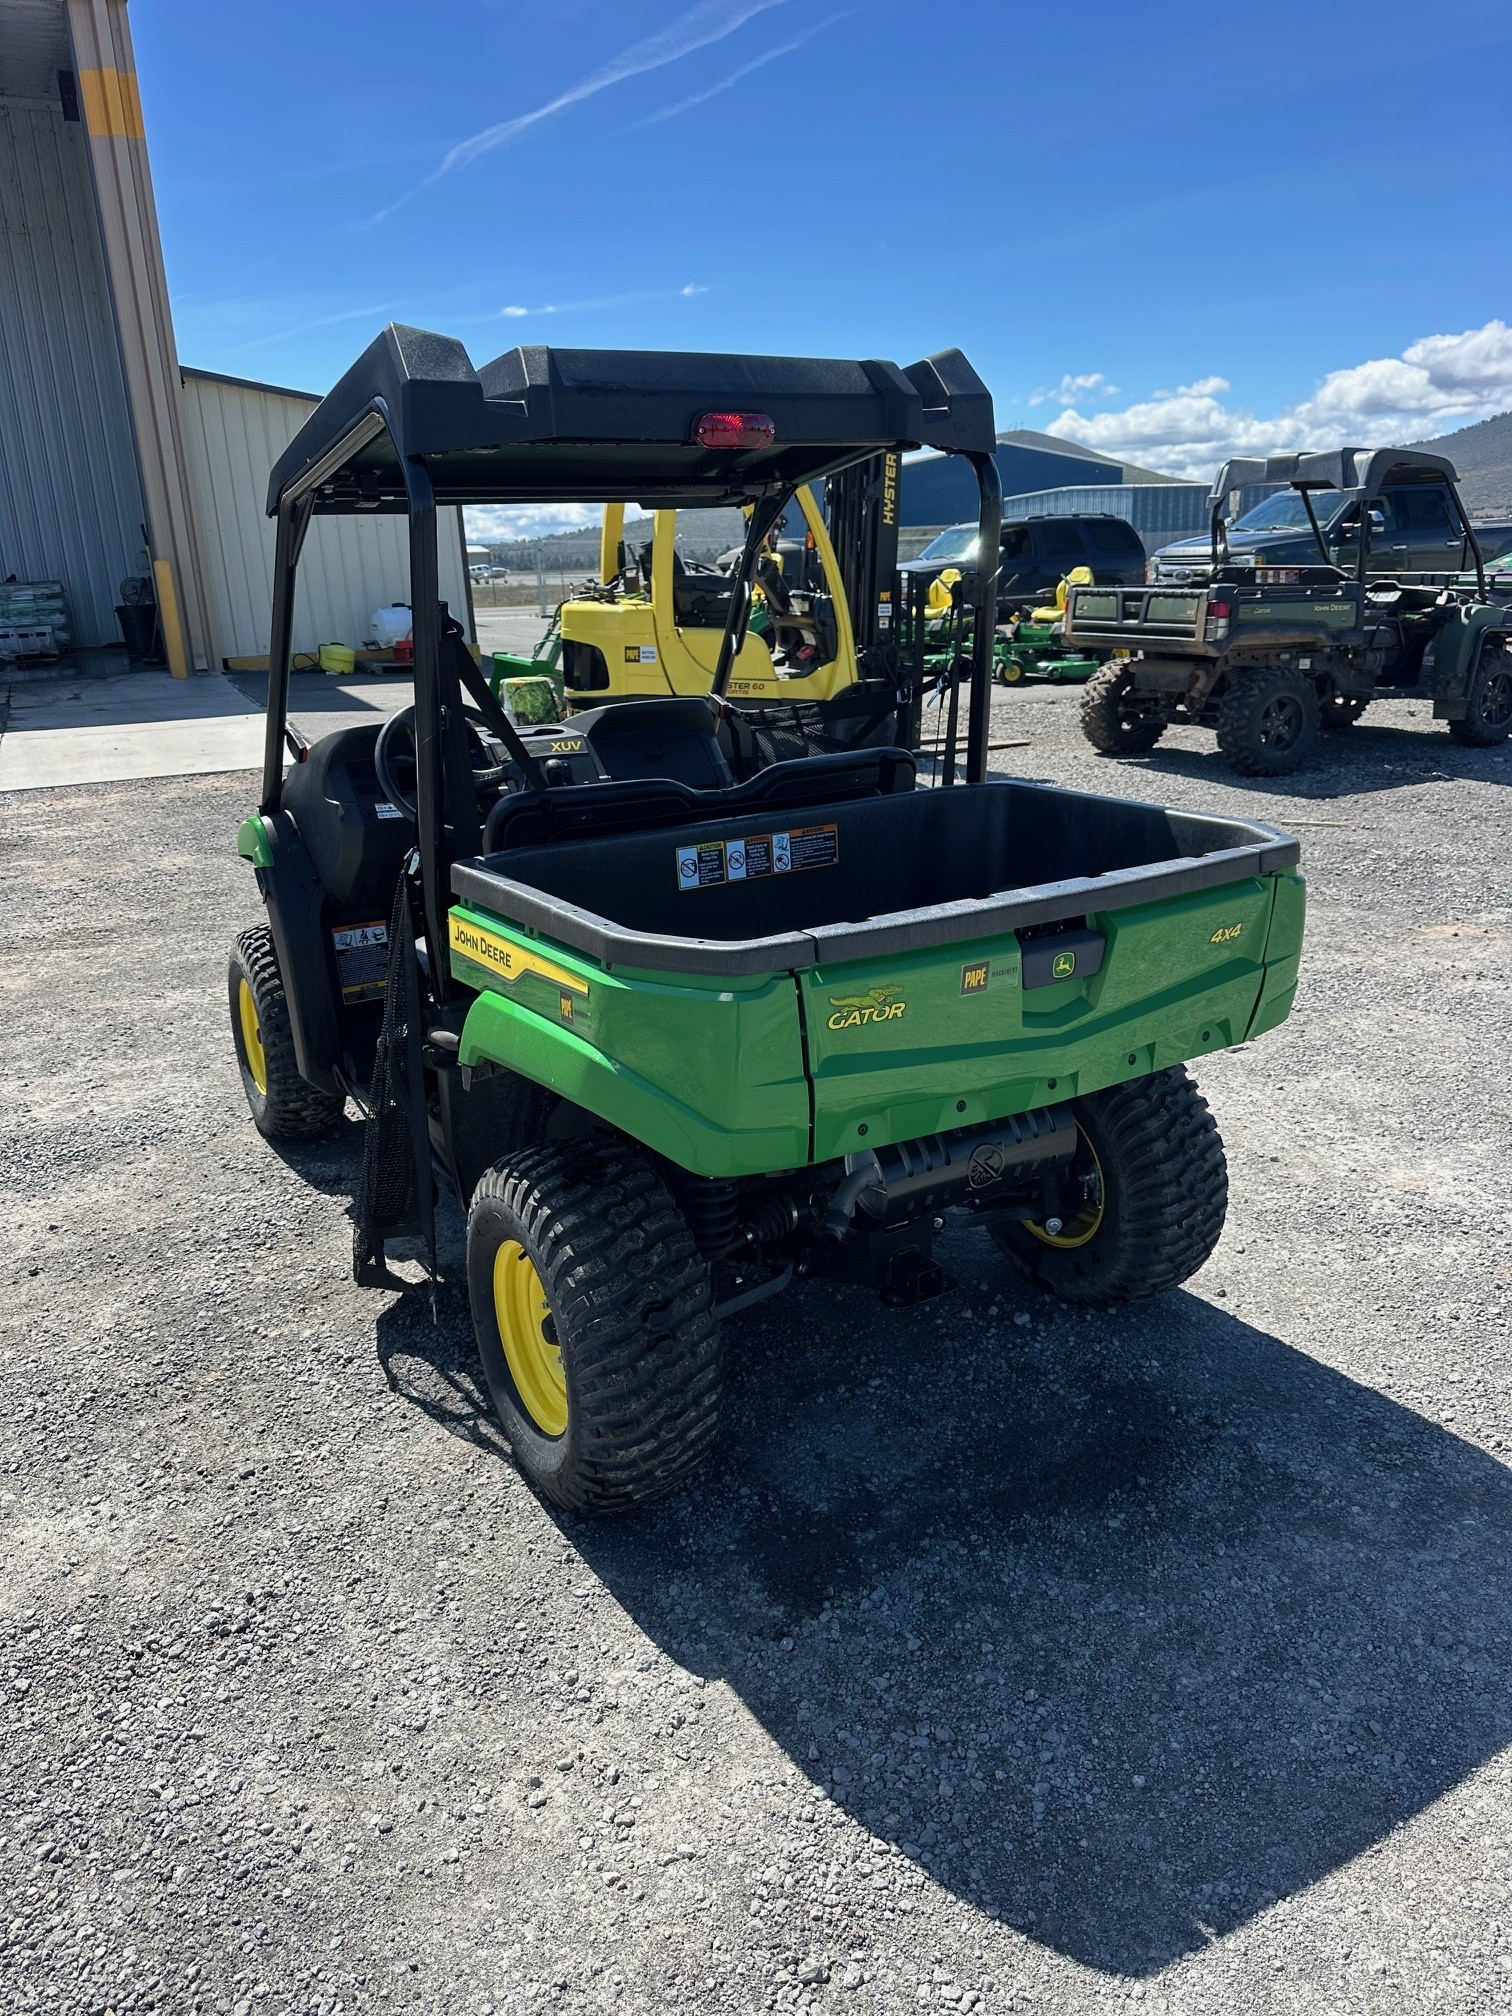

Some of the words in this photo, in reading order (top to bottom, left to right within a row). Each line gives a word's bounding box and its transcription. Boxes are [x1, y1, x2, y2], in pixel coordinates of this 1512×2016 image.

[883, 453, 897, 525] HYSTER
[727, 682, 750, 690] STER
[752, 682, 765, 690] 60
[550, 741, 581, 752] XUV
[454, 926, 479, 952] JOHN
[480, 937, 512, 970] DEERE
[828, 1002, 906, 1030] GATOR
